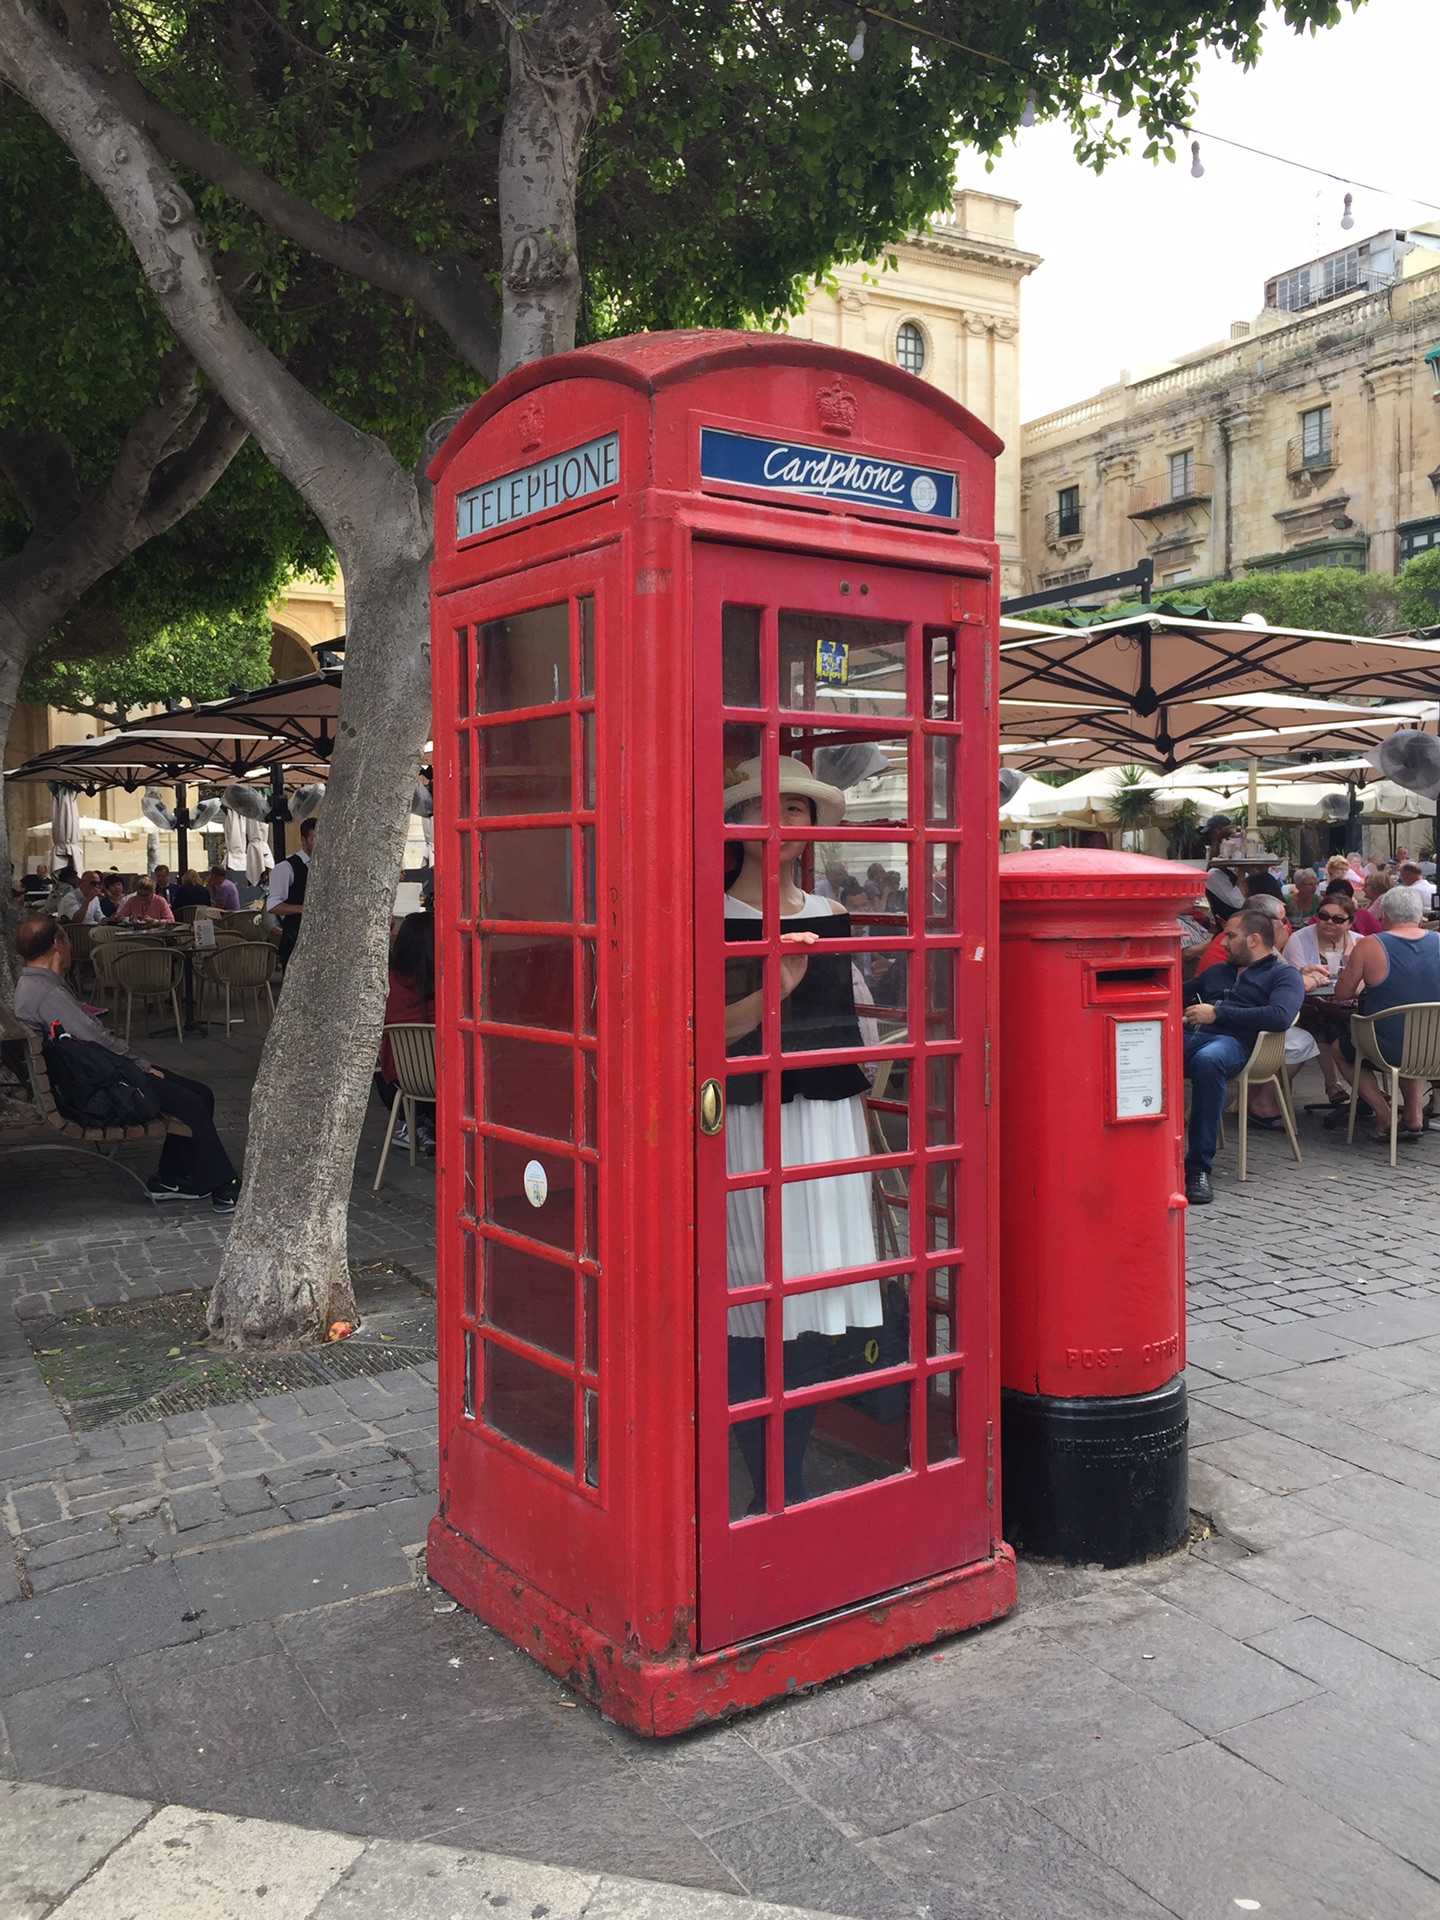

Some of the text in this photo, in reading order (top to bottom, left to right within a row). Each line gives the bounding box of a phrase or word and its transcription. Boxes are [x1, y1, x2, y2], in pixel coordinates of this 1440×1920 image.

[466, 442, 615, 533] TELEPHONE
[763, 447, 905, 495] Cardphone
[1065, 1348, 1123, 1369] POST
